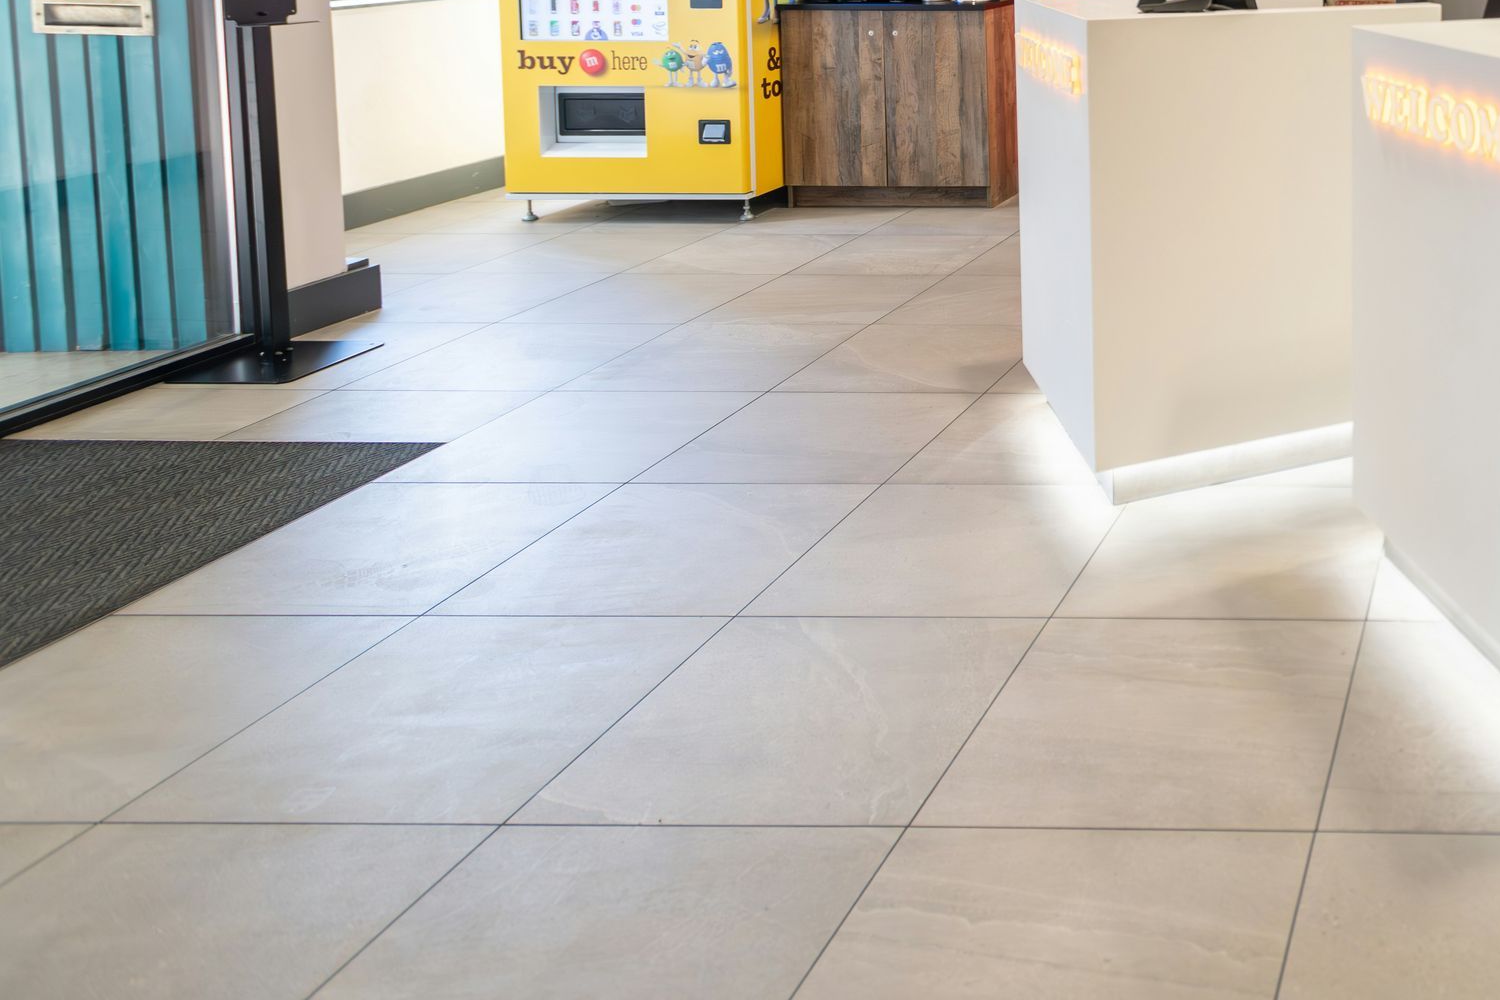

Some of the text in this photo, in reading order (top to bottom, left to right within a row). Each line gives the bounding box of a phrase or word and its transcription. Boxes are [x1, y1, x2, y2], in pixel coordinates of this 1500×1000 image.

[517, 50, 575, 75] buy
[611, 50, 648, 71] here
[767, 47, 781, 71] &
